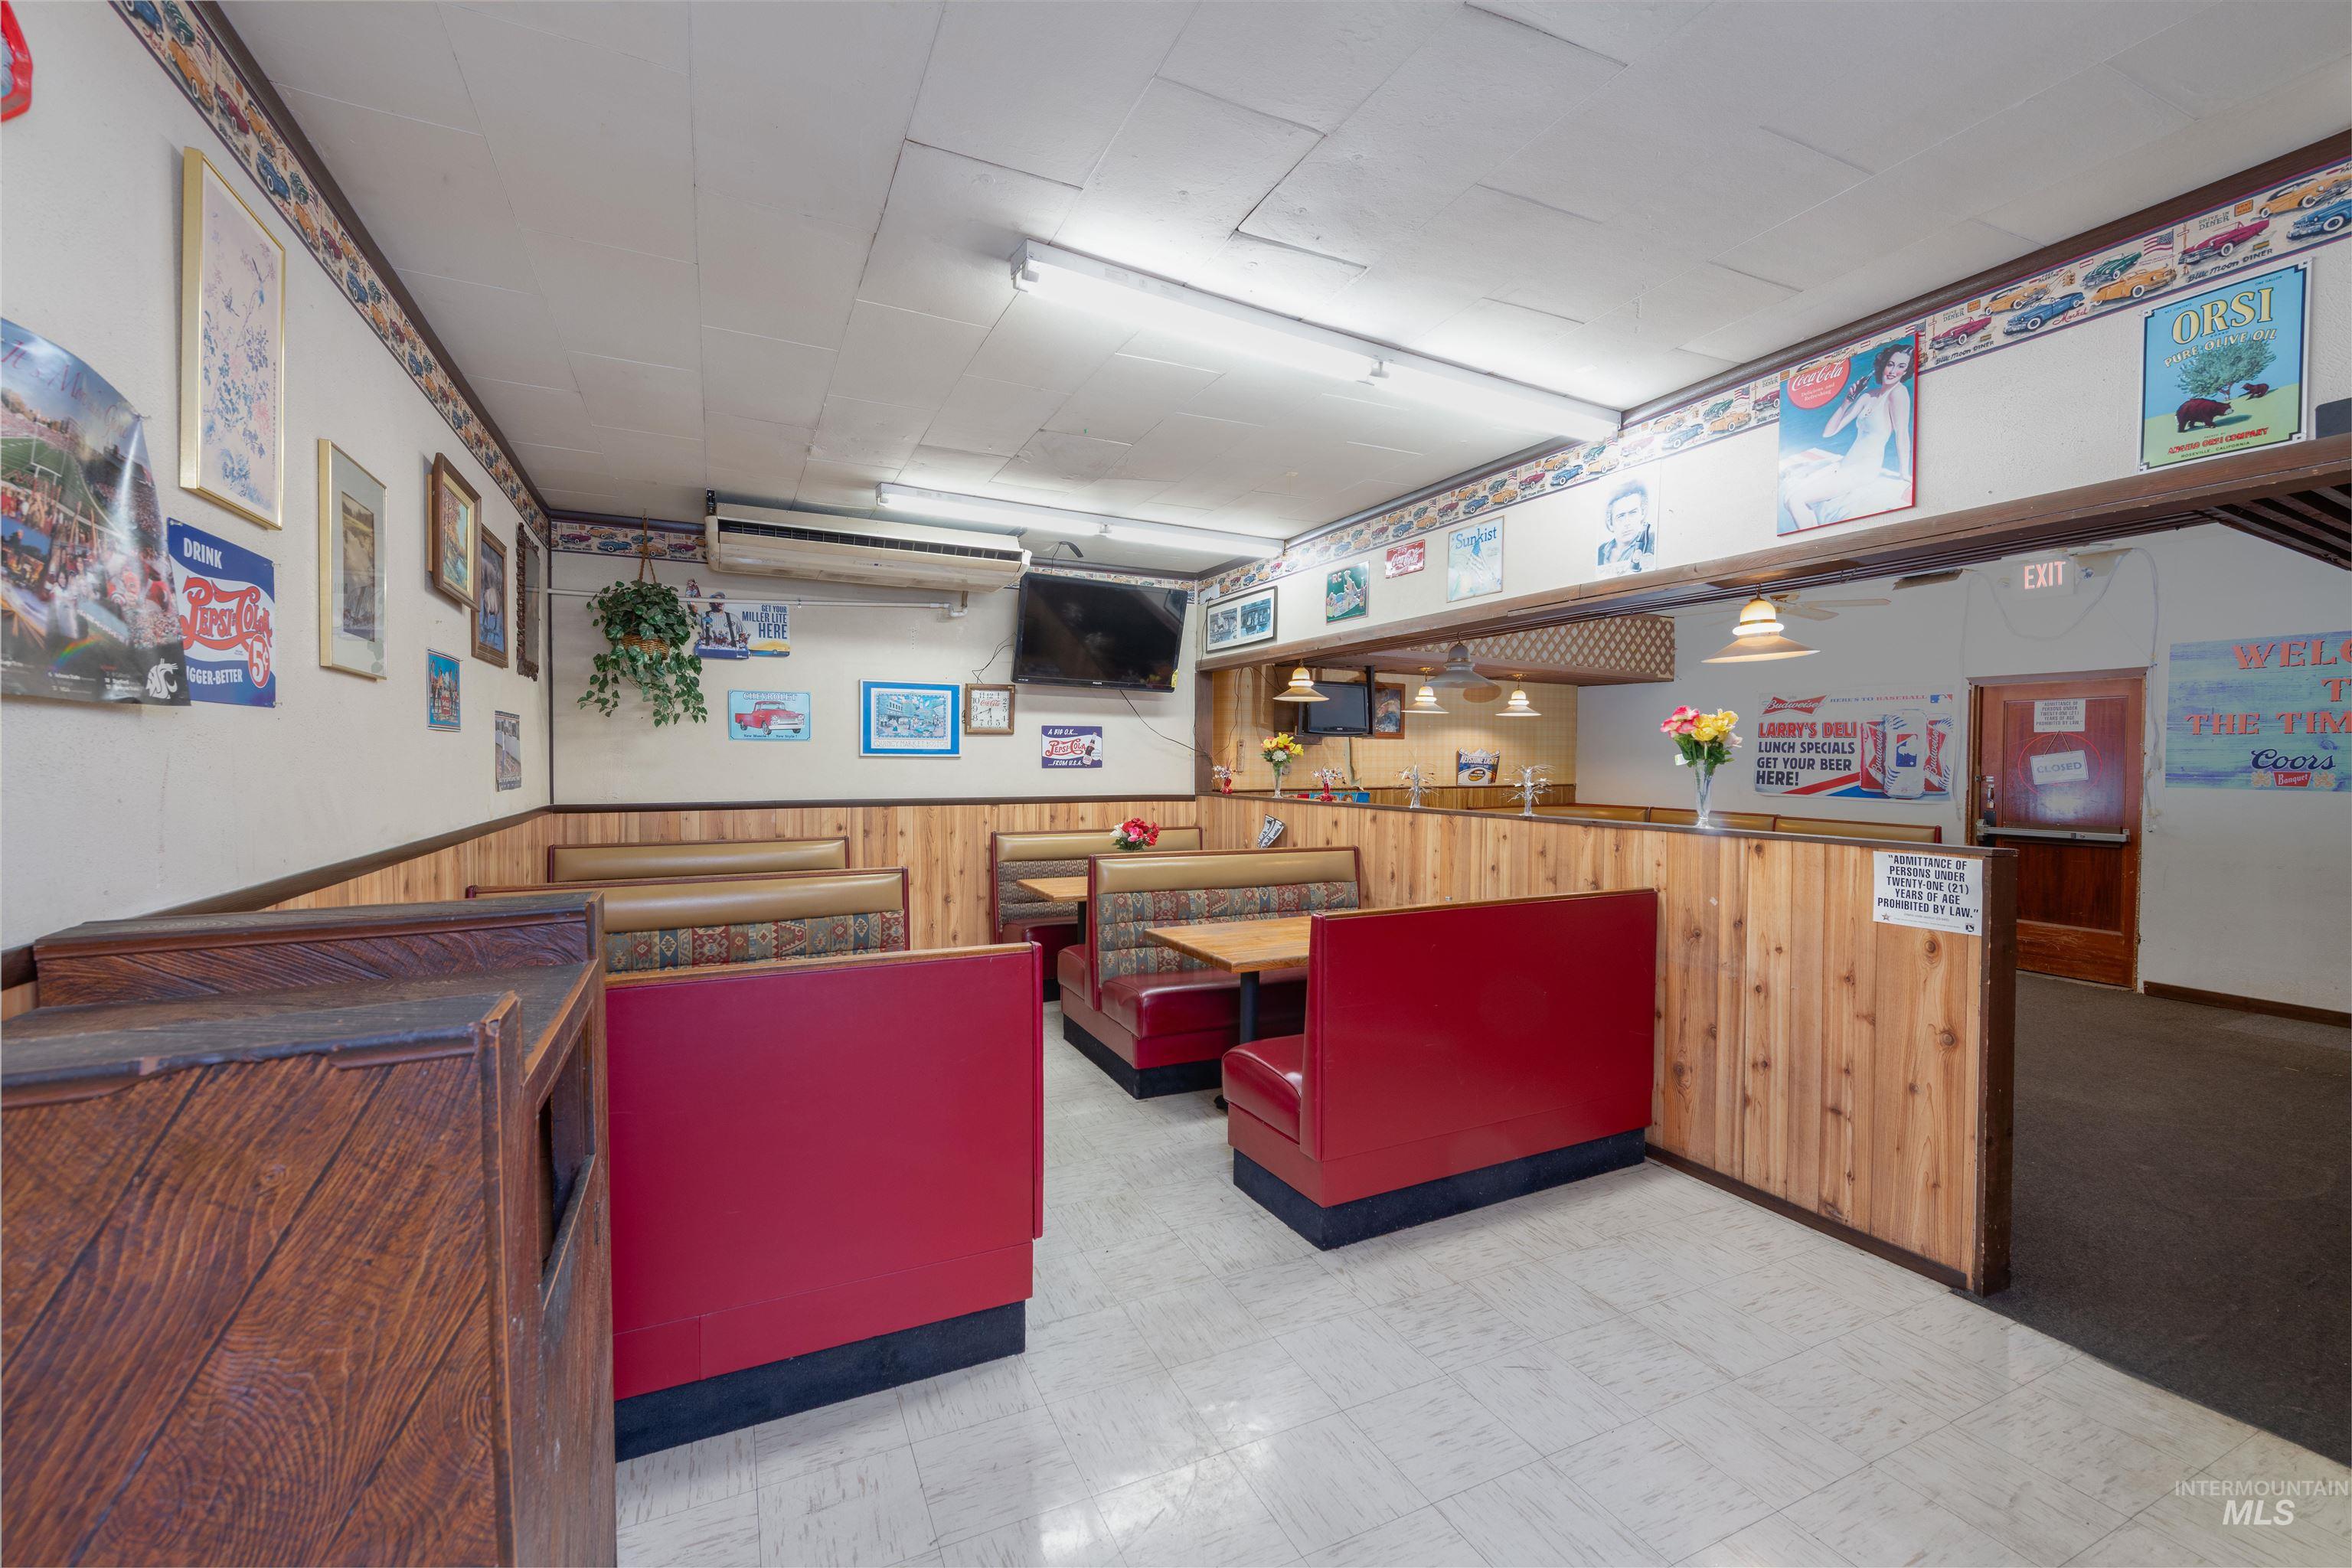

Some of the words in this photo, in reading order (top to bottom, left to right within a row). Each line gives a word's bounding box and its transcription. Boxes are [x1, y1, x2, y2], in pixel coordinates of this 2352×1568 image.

[2199, 216, 2230, 230] DINER
[2243, 248, 2273, 263] DINER
[1943, 311, 1965, 322] DINER
[2172, 287, 2274, 345] ORSI
[1973, 341, 1994, 352] DINER
[2164, 345, 2200, 368] PURE
[2204, 332, 2248, 351] OLIVE
[2252, 328, 2278, 341] OIL
[1804, 390, 1832, 401] Refreshing
[2167, 441, 2200, 455] ANGELO
[2202, 436, 2223, 448] ORSI
[2225, 427, 2269, 443] COMPANY
[2216, 441, 2251, 451] CALIFORNIA
[1455, 527, 1498, 550] Sunkist
[183, 537, 223, 570] DRINK
[1332, 573, 1342, 583] RC
[2024, 560, 2066, 590] EXIT
[742, 611, 769, 622] MILLER
[773, 605, 787, 613] YOUR
[758, 622, 788, 639] HERE
[186, 665, 243, 685] IGGER-BETTER
[743, 692, 797, 701] CHEVROLET
[1758, 721, 1818, 739] LARRY'S
[1822, 721, 1857, 739] DELI
[2185, 713, 2260, 735] THE
[1758, 742, 1796, 753] LUNCH
[1799, 742, 1855, 755] SPECIALS
[1460, 754, 1485, 764] KEYSTONE
[1756, 757, 1779, 769] GET
[1782, 758, 1816, 771] YOUR
[1821, 759, 1852, 771] BEER
[2251, 749, 2336, 770] Coors
[2037, 762, 2082, 773] CLOSED
[1756, 770, 1799, 786] HERE!
[2278, 773, 2308, 786] Banquet
[1955, 861, 1968, 871] OF
[1890, 866, 1931, 879] PERSONS
[1935, 870, 1965, 882] UNDER
[1886, 877, 1945, 892] TWENTY-ONE
[1948, 883, 1969, 895] (21)
[1895, 888, 1923, 900] YEARS
[1927, 892, 1939, 902] OF
[1942, 893, 1960, 905] AGE
[1877, 897, 1929, 913] PROHIBITED
[1933, 904, 1945, 915] BY
